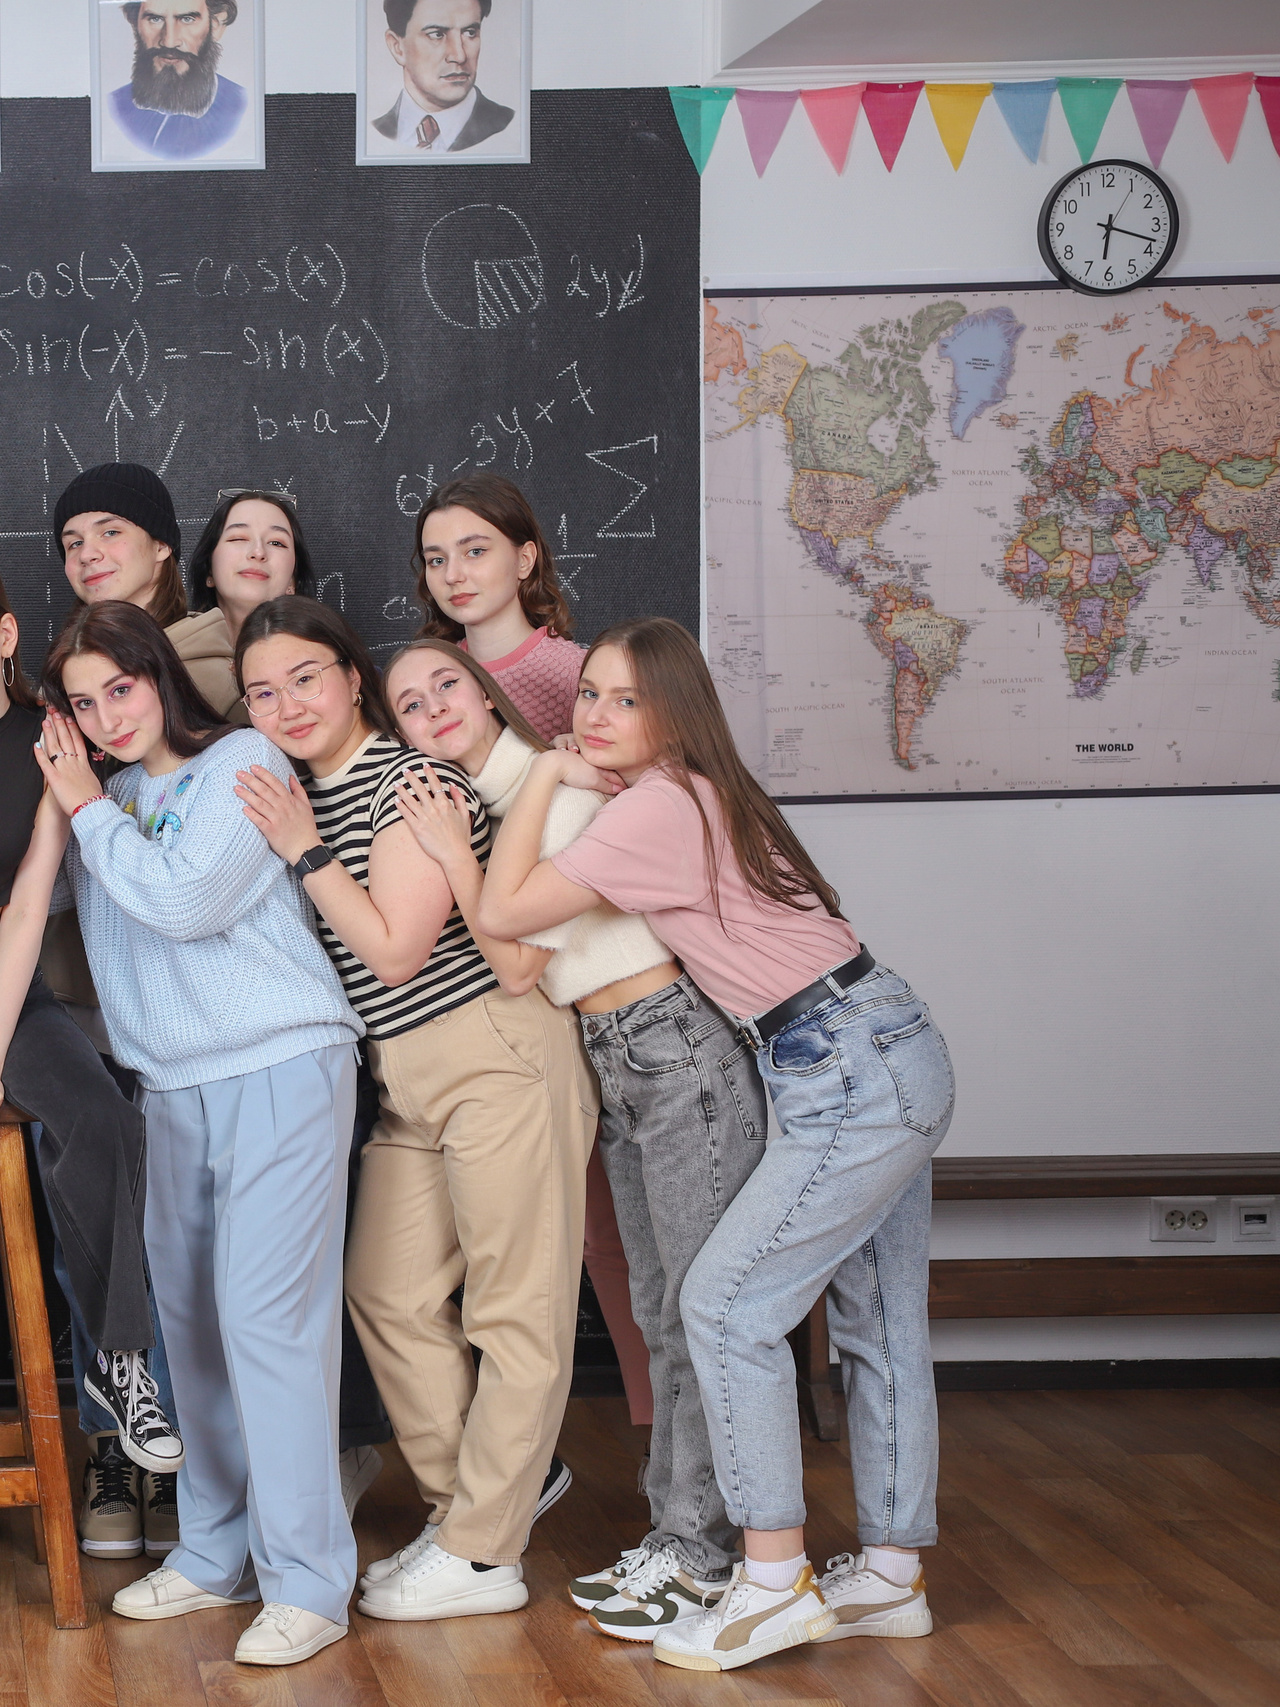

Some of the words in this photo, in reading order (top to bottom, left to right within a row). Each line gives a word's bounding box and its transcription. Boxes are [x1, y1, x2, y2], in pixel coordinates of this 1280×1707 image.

[1101, 173, 1115, 188] 12
[1129, 179, 1133, 192] 1
[1080, 182, 1090, 196] 11
[1064, 200, 1077, 214] 10
[1143, 194, 1152, 208] 2
[1056, 222, 1064, 237] 9
[1151, 217, 1160, 232] 3
[1064, 245, 1073, 259] 8
[1143, 242, 1153, 257] 4
[1085, 261, 1093, 276] 7
[1104, 266, 1113, 281] 6
[1127, 259, 1136, 274] 5
[1064, 322, 1089, 330] OCEAN
[821, 430, 852, 440] CANADA
[736, 498, 762, 507] OCEAN
[982, 677, 1006, 685] SOUTH
[765, 706, 790, 714] SOUTH
[794, 704, 820, 712] PACIFIC
[821, 703, 845, 711] OCEAN
[1076, 744, 1095, 752] THE
[1098, 743, 1134, 752] WORLD
